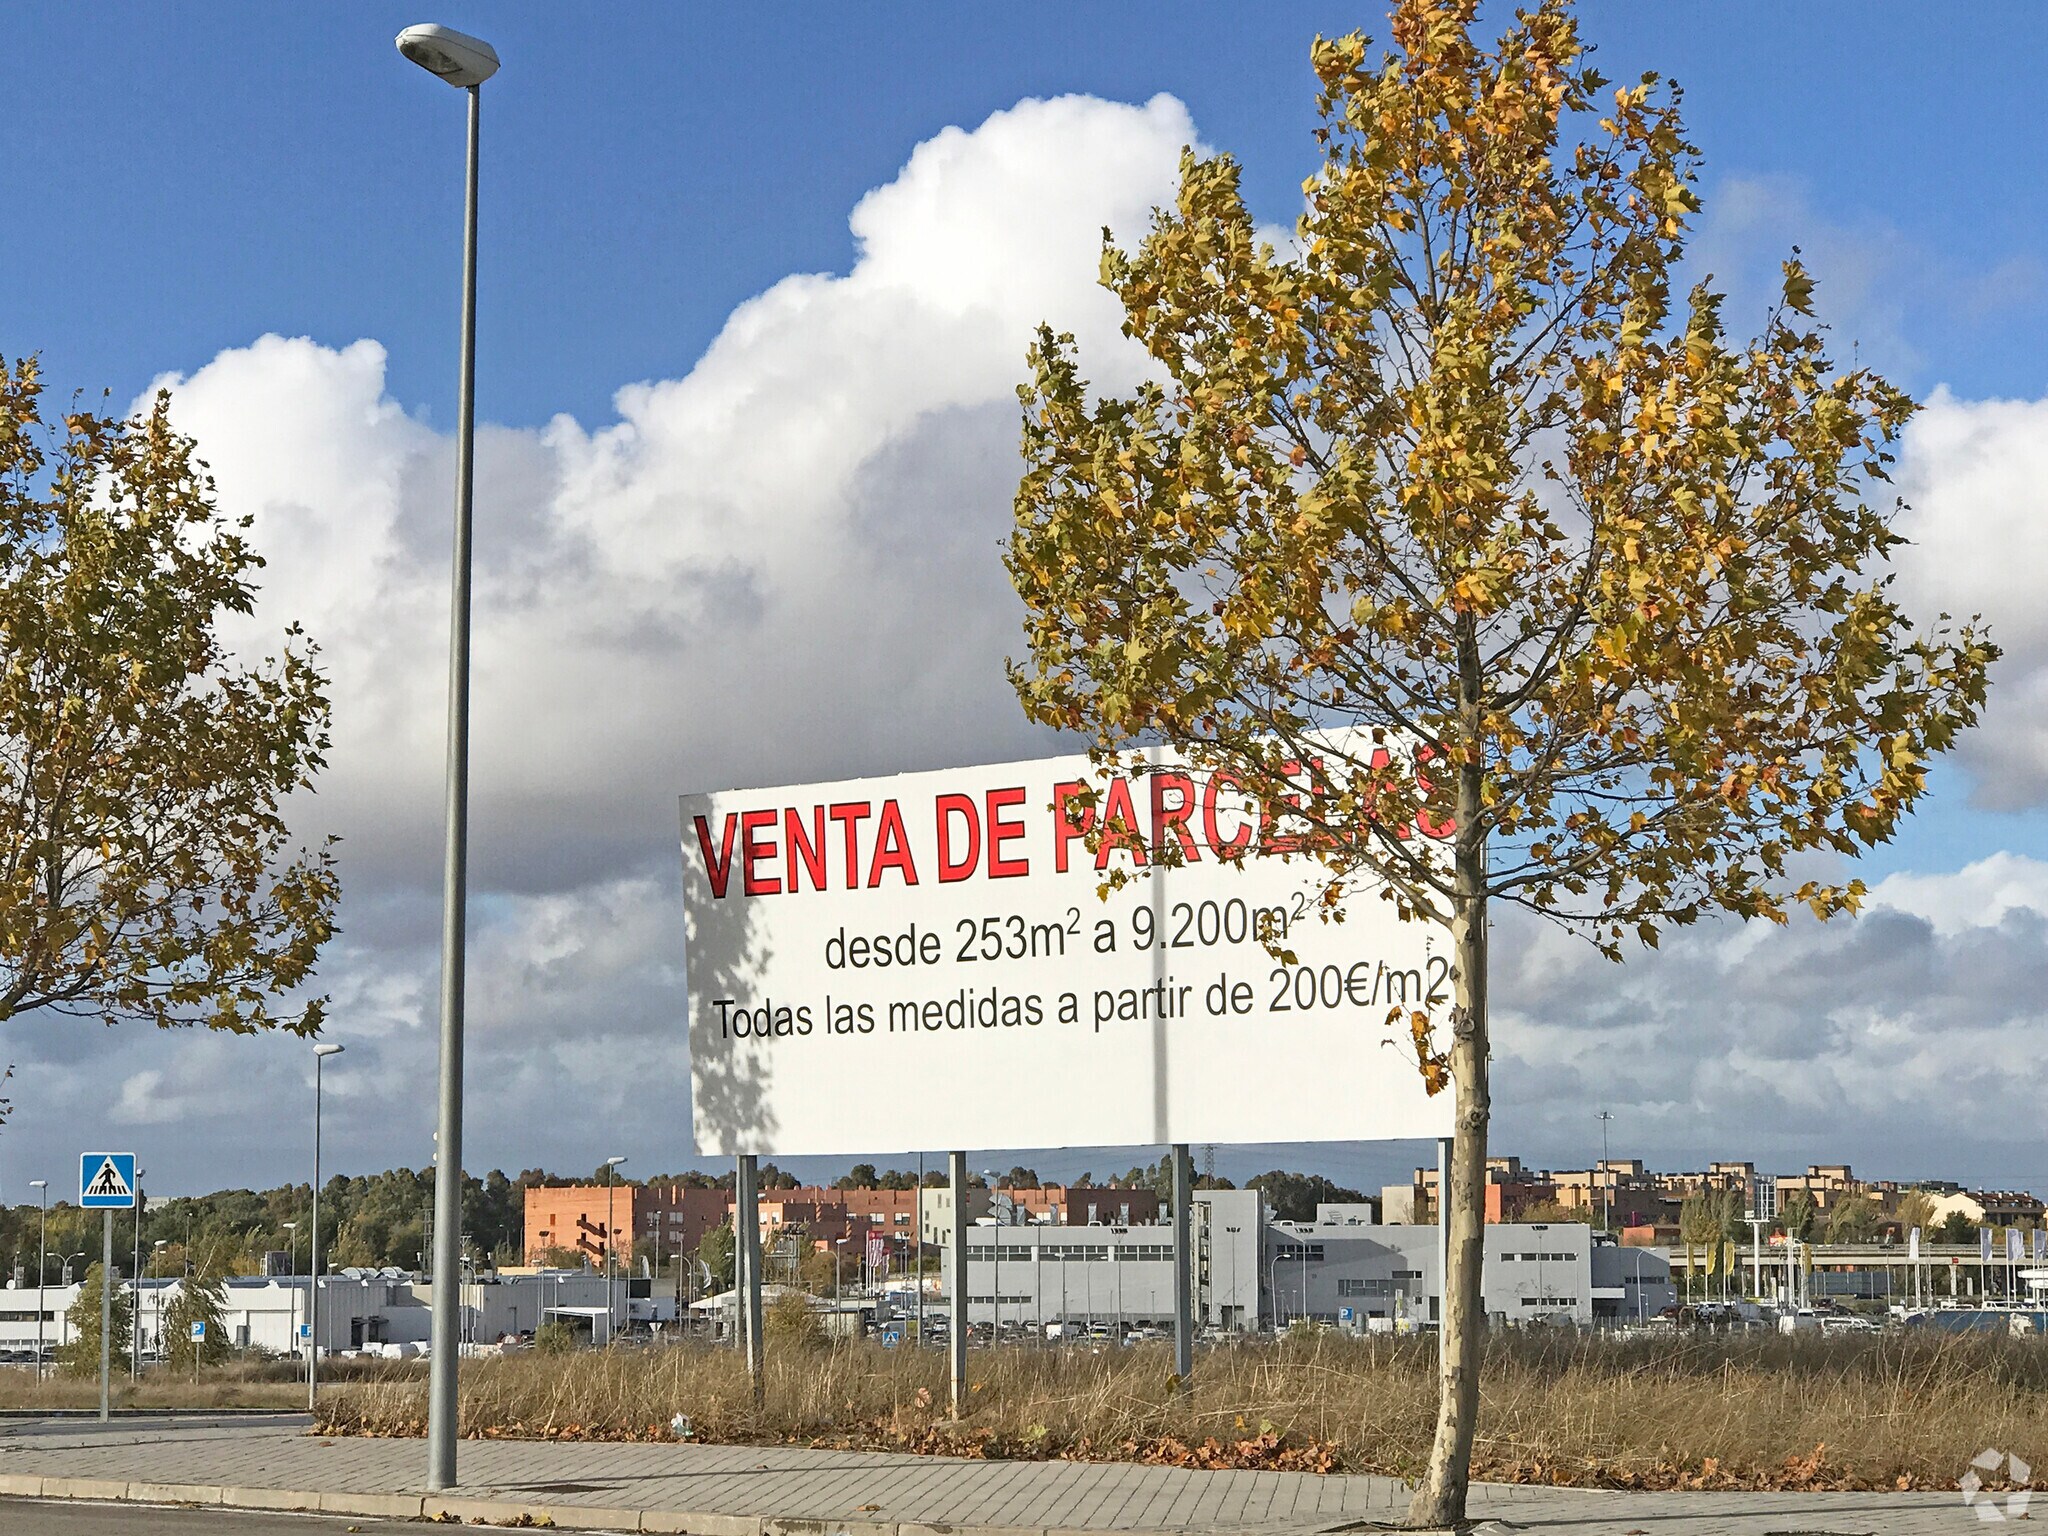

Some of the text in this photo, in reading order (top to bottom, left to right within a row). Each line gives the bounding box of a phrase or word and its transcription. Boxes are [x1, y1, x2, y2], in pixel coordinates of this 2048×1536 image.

[693, 798, 919, 899] VENTA
[935, 786, 1030, 884] DE
[825, 922, 941, 970] desde
[1093, 917, 1116, 954] a
[712, 955, 1450, 1039] Todas las medidas a partir de 200€/m2
